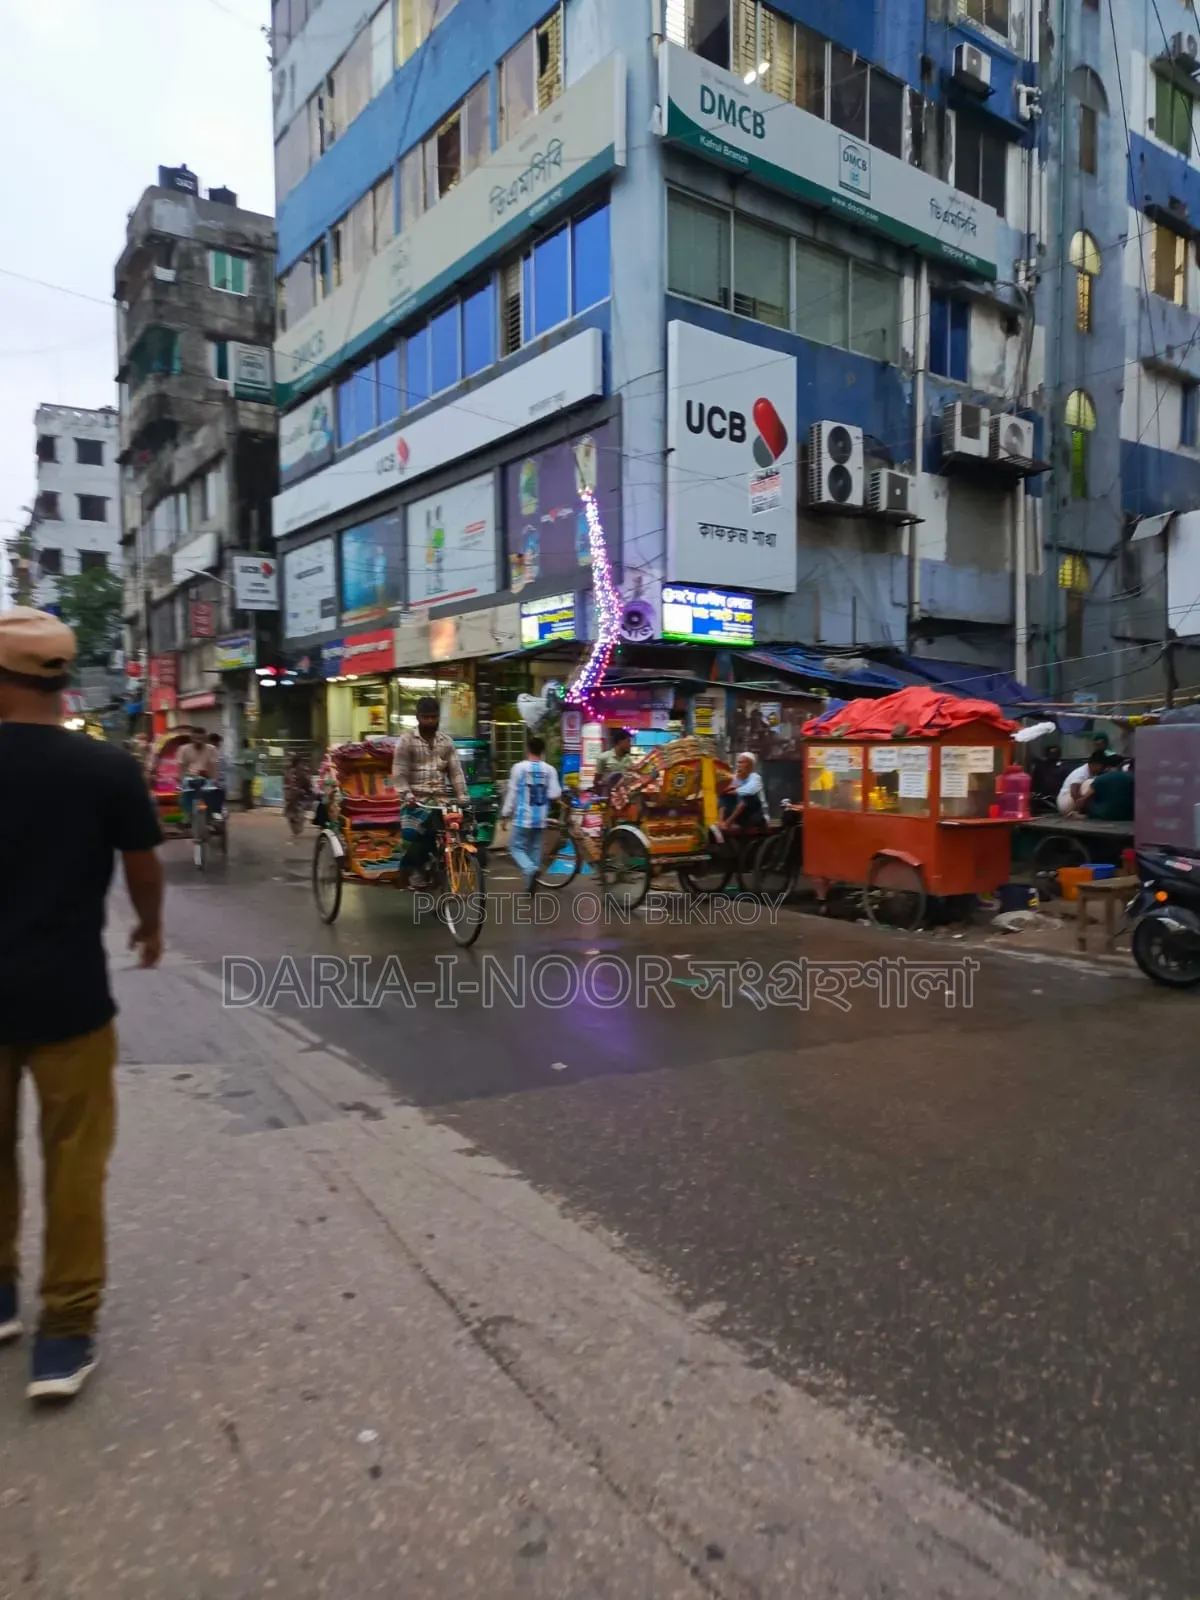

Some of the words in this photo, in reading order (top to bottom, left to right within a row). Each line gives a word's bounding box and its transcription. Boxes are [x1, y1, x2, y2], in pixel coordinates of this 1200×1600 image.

[700, 84, 766, 140] DMCB
[843, 150, 868, 171] DMCB
[686, 399, 746, 443] UCB
